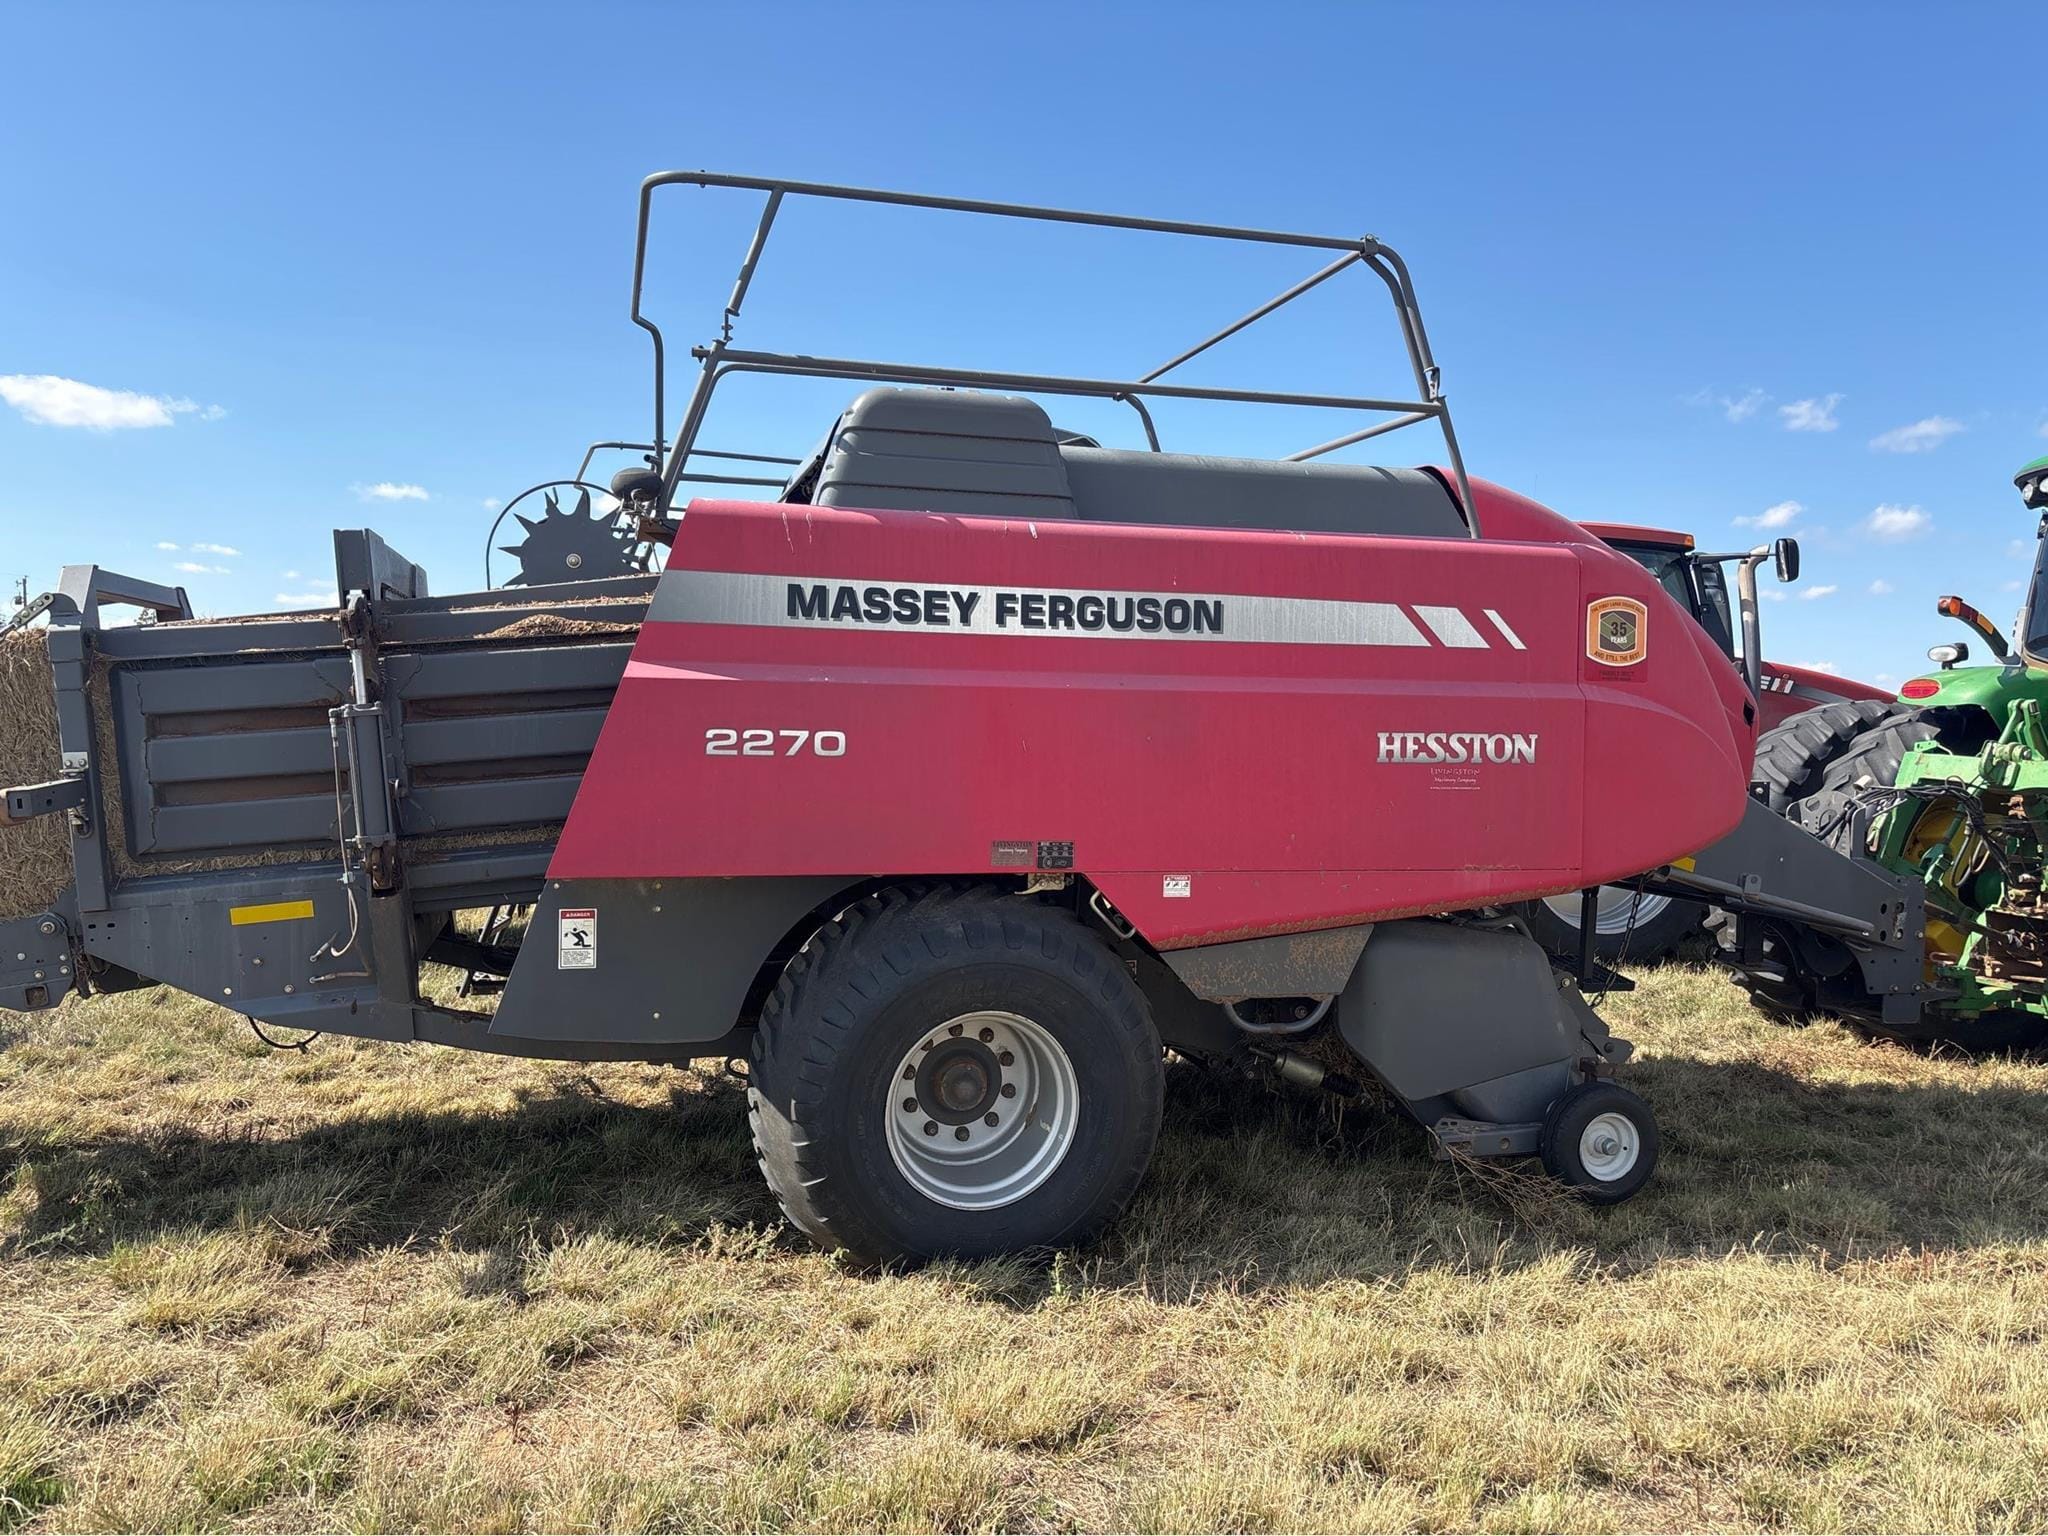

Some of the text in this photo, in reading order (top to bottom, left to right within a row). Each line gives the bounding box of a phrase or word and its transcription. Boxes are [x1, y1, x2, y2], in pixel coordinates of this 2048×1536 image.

[787, 583, 1224, 634] MASSEY FERGUSON
[1611, 622, 1627, 636] 35
[1605, 654, 1618, 662] STILL
[705, 728, 847, 757] 2270
[1376, 732, 1538, 764] HESSTON
